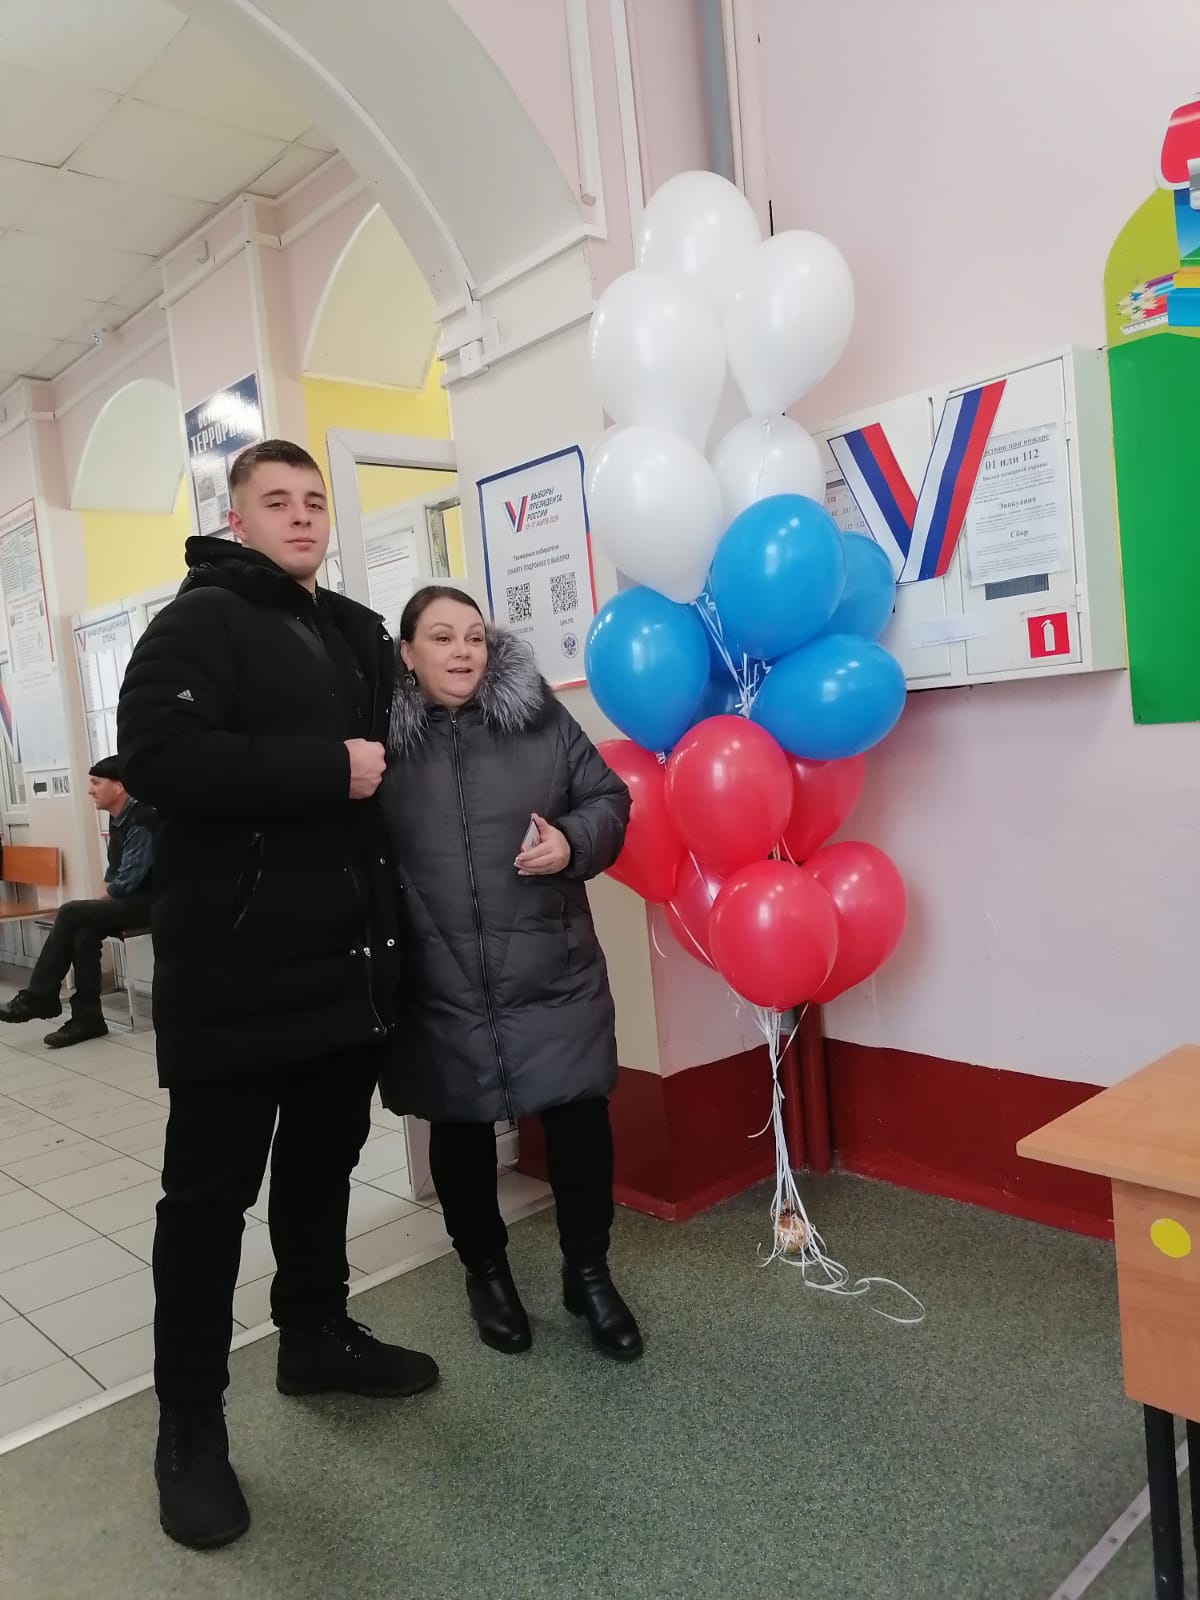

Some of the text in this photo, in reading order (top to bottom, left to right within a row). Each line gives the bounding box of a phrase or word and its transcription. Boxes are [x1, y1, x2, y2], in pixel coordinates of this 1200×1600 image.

[985, 448, 1039, 470] 01 или 112
[530, 486, 555, 501] ВЫБОРЫ
[529, 494, 562, 511] ПРЕЗИДЕНТА
[527, 509, 548, 522] РОССИИ
[1010, 530, 1028, 538] Сбор
